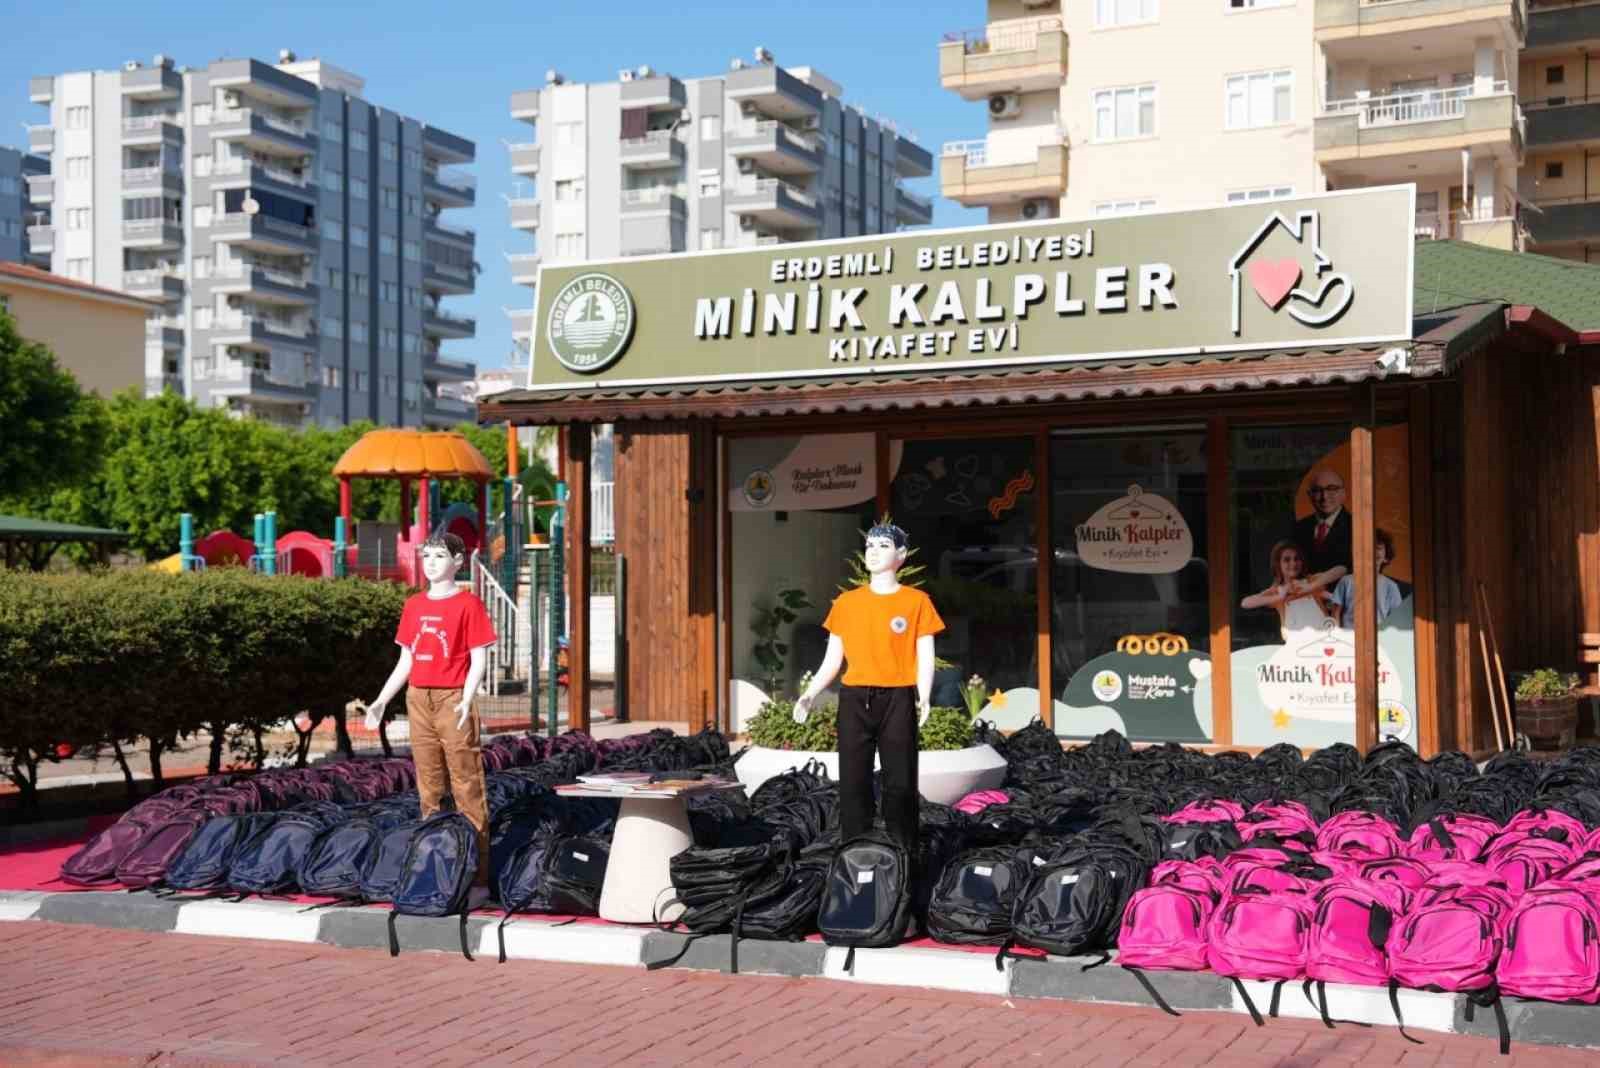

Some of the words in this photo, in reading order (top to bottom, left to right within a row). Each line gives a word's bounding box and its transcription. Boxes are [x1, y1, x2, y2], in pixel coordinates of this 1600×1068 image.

[770, 246, 892, 281] ERDEMLİ
[916, 228, 1094, 270] BELEDİYESİ
[551, 280, 585, 339] ERDEMLİ
[694, 282, 867, 338] MİNİK
[888, 262, 1179, 326] KALPLER
[829, 329, 956, 361] KIYAFET
[966, 322, 1018, 352] EVİ
[573, 353, 599, 365] 1954
[1075, 525, 1121, 543] Minik
[1123, 523, 1185, 545] Kalpler
[1127, 674, 1177, 687] Mustafa
[1257, 663, 1312, 684] Minik
